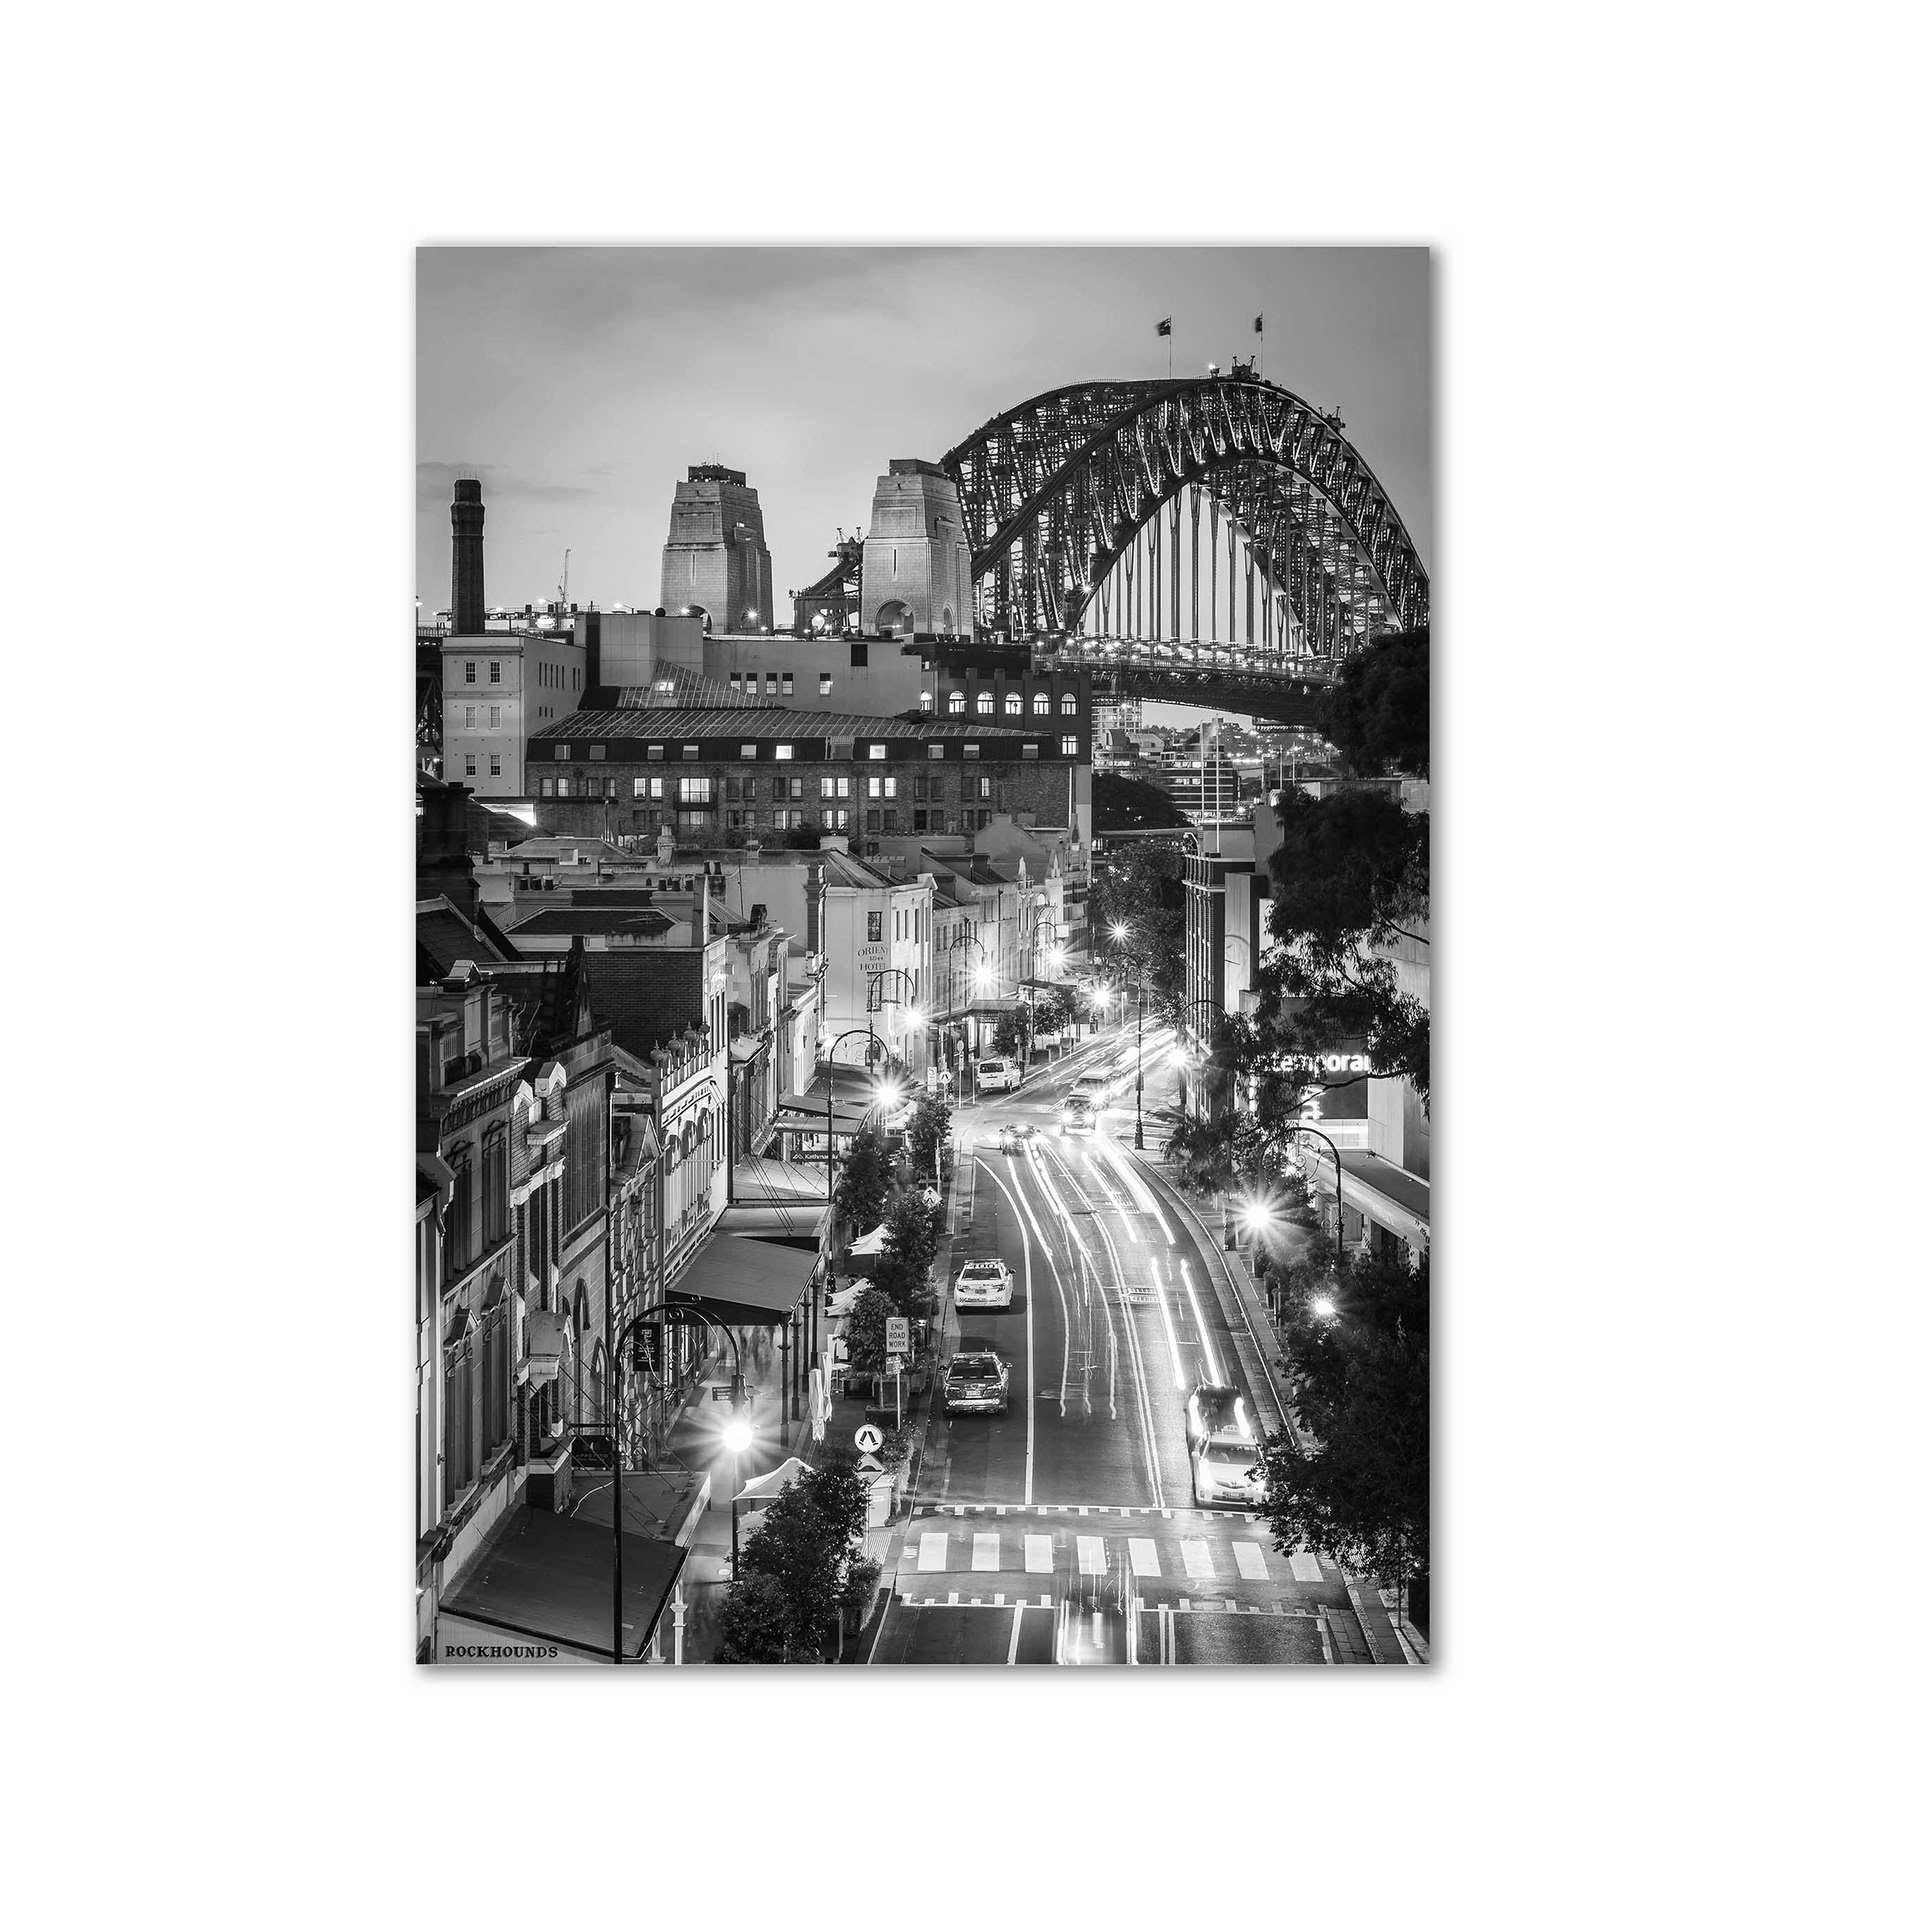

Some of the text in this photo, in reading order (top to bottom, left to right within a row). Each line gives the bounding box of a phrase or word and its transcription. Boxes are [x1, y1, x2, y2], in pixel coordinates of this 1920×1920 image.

[860, 962, 887, 971] HOTEL
[890, 1323, 904, 1331] END
[889, 1340, 906, 1348] WORK
